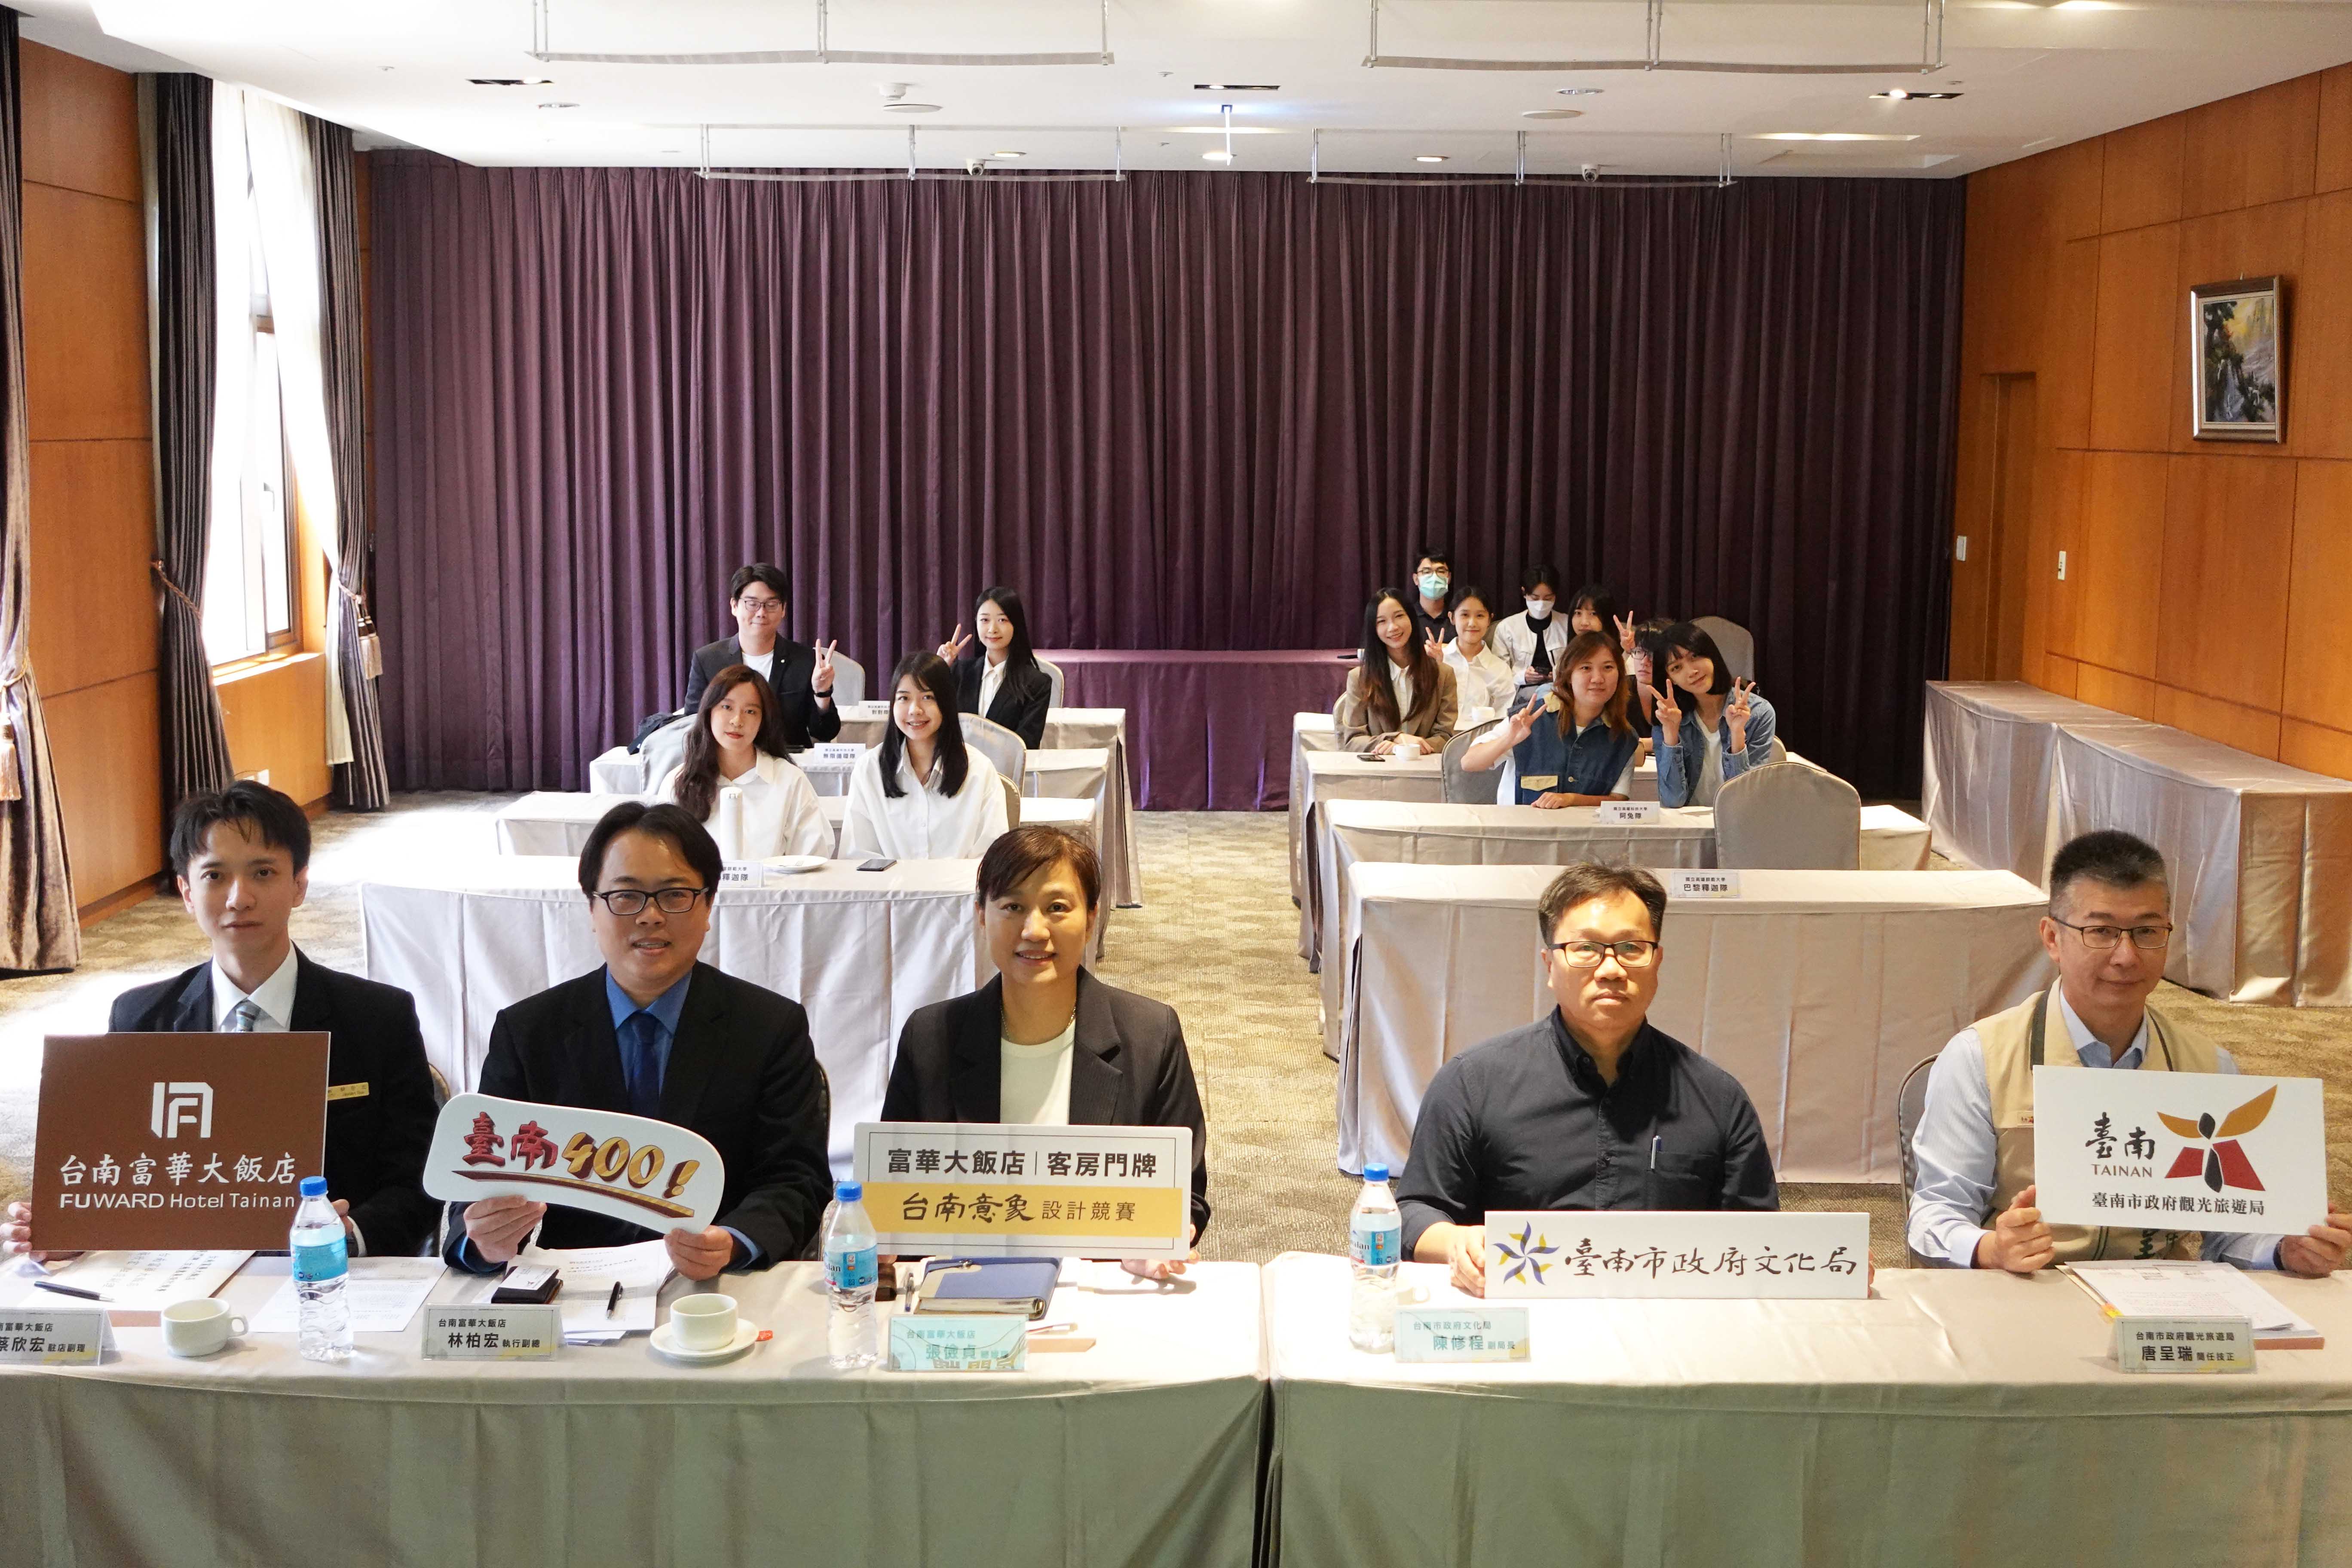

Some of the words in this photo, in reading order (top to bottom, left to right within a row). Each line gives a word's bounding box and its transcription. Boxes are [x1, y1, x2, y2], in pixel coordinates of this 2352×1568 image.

[1684, 883, 1728, 892] 巴黎釋迦隊
[2085, 1111, 2156, 1160] 臺南
[60, 1151, 296, 1186] 台南富華大飯店
[887, 1148, 1026, 1176] 富華大飯店
[1047, 1152, 1158, 1178] 客房門牌
[2091, 1164, 2153, 1178] TAINAN
[60, 1193, 165, 1208] FUWARD
[170, 1193, 224, 1208] Hotel
[230, 1193, 295, 1208] Tainan
[903, 1192, 1036, 1223] 台南意象
[1042, 1200, 1136, 1222] 設計競賽
[2092, 1191, 2265, 1216] 臺南市政府觀光旅遊局
[1565, 1237, 1857, 1280] 臺南市政府文化局
[438, 1318, 507, 1328] 台南富華大飯店
[447, 1332, 499, 1348] 林柏宏
[502, 1339, 540, 1348] 執行副總
[2136, 1331, 2235, 1341] 台南市政府觀光旅遊局
[47, 1343, 86, 1352] 駐店副理
[2141, 1345, 2193, 1362] 唐呈瑞
